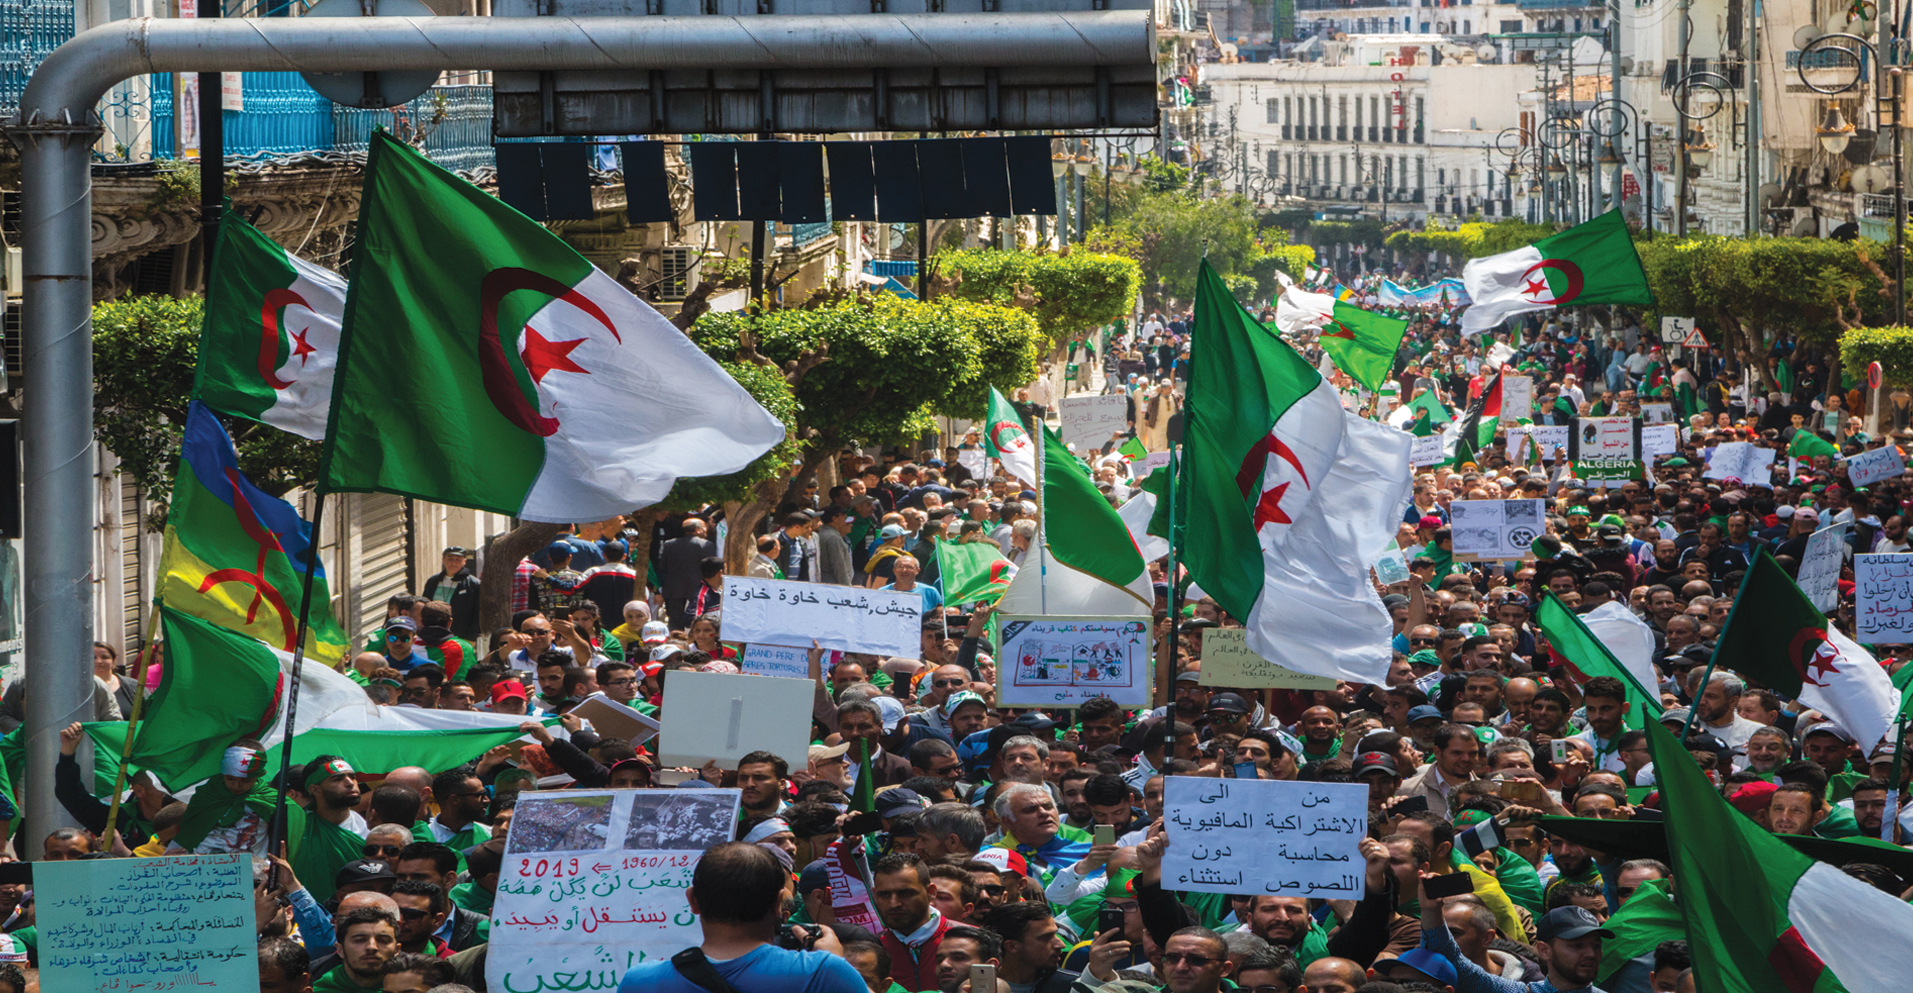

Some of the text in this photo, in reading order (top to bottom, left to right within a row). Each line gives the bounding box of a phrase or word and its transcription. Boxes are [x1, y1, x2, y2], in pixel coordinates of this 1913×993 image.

[1390, 57, 1404, 130] HOTEL
[1577, 461, 1637, 469] ALGERIA
[1586, 470, 1631, 481] الجزائر
[730, 584, 771, 602] خاوة
[778, 588, 820, 605] خاوة
[1057, 624, 1078, 634] كتاب
[745, 648, 773, 659] GRAND
[767, 662, 802, 674] TORTURES
[288, 646, 304, 714] EPICA
[1199, 783, 1331, 808] من الى
[1171, 808, 1364, 836] الاشتراكية المافيوية
[1191, 843, 1350, 864] محاسبة دون
[519, 858, 580, 878] 2019
[1178, 867, 1360, 895] اللصوص استثناء
